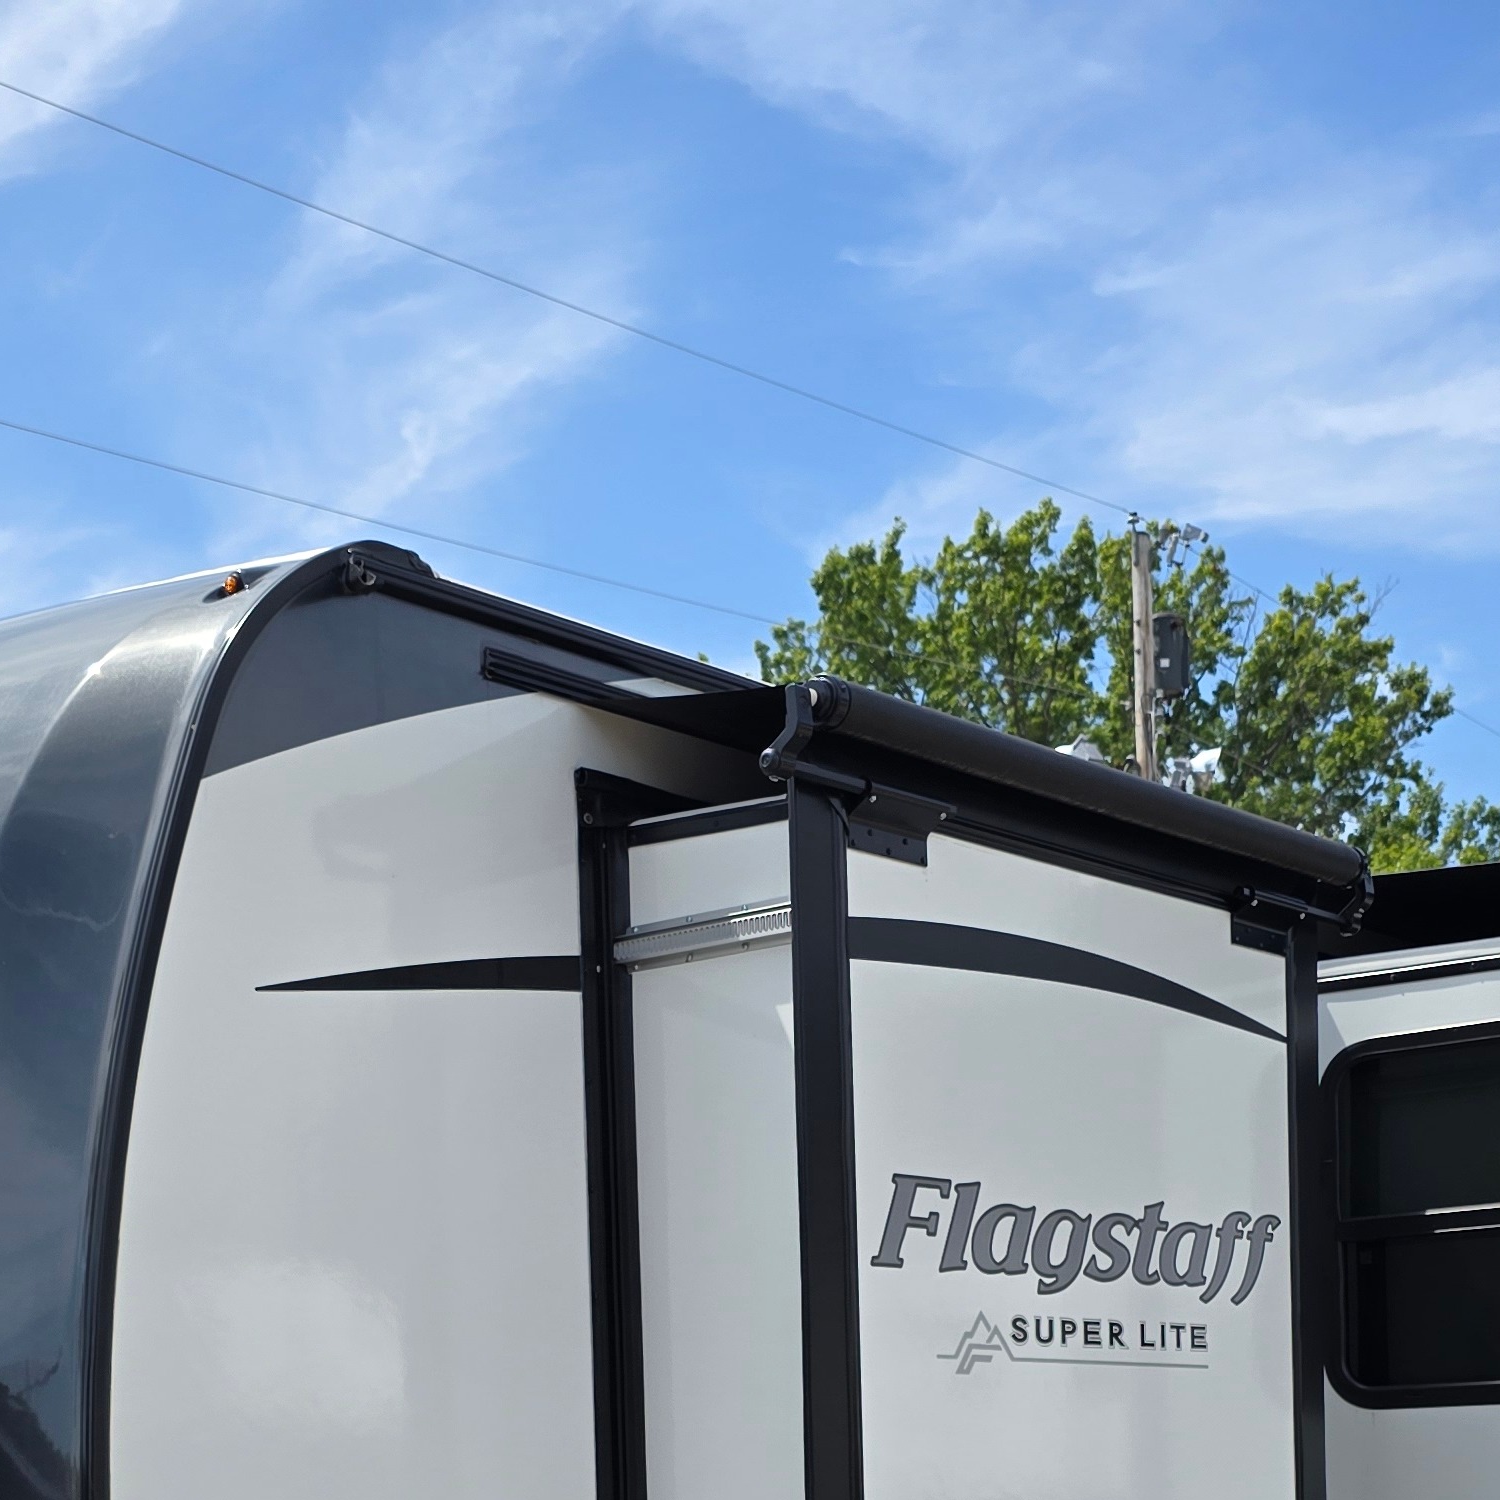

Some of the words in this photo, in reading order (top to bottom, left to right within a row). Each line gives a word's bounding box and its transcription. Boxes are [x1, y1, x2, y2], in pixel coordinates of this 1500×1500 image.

[870, 1172, 1282, 1306] Flagstaff
[1009, 1313, 1128, 1350] SUPER
[1139, 1321, 1210, 1352] LITE
